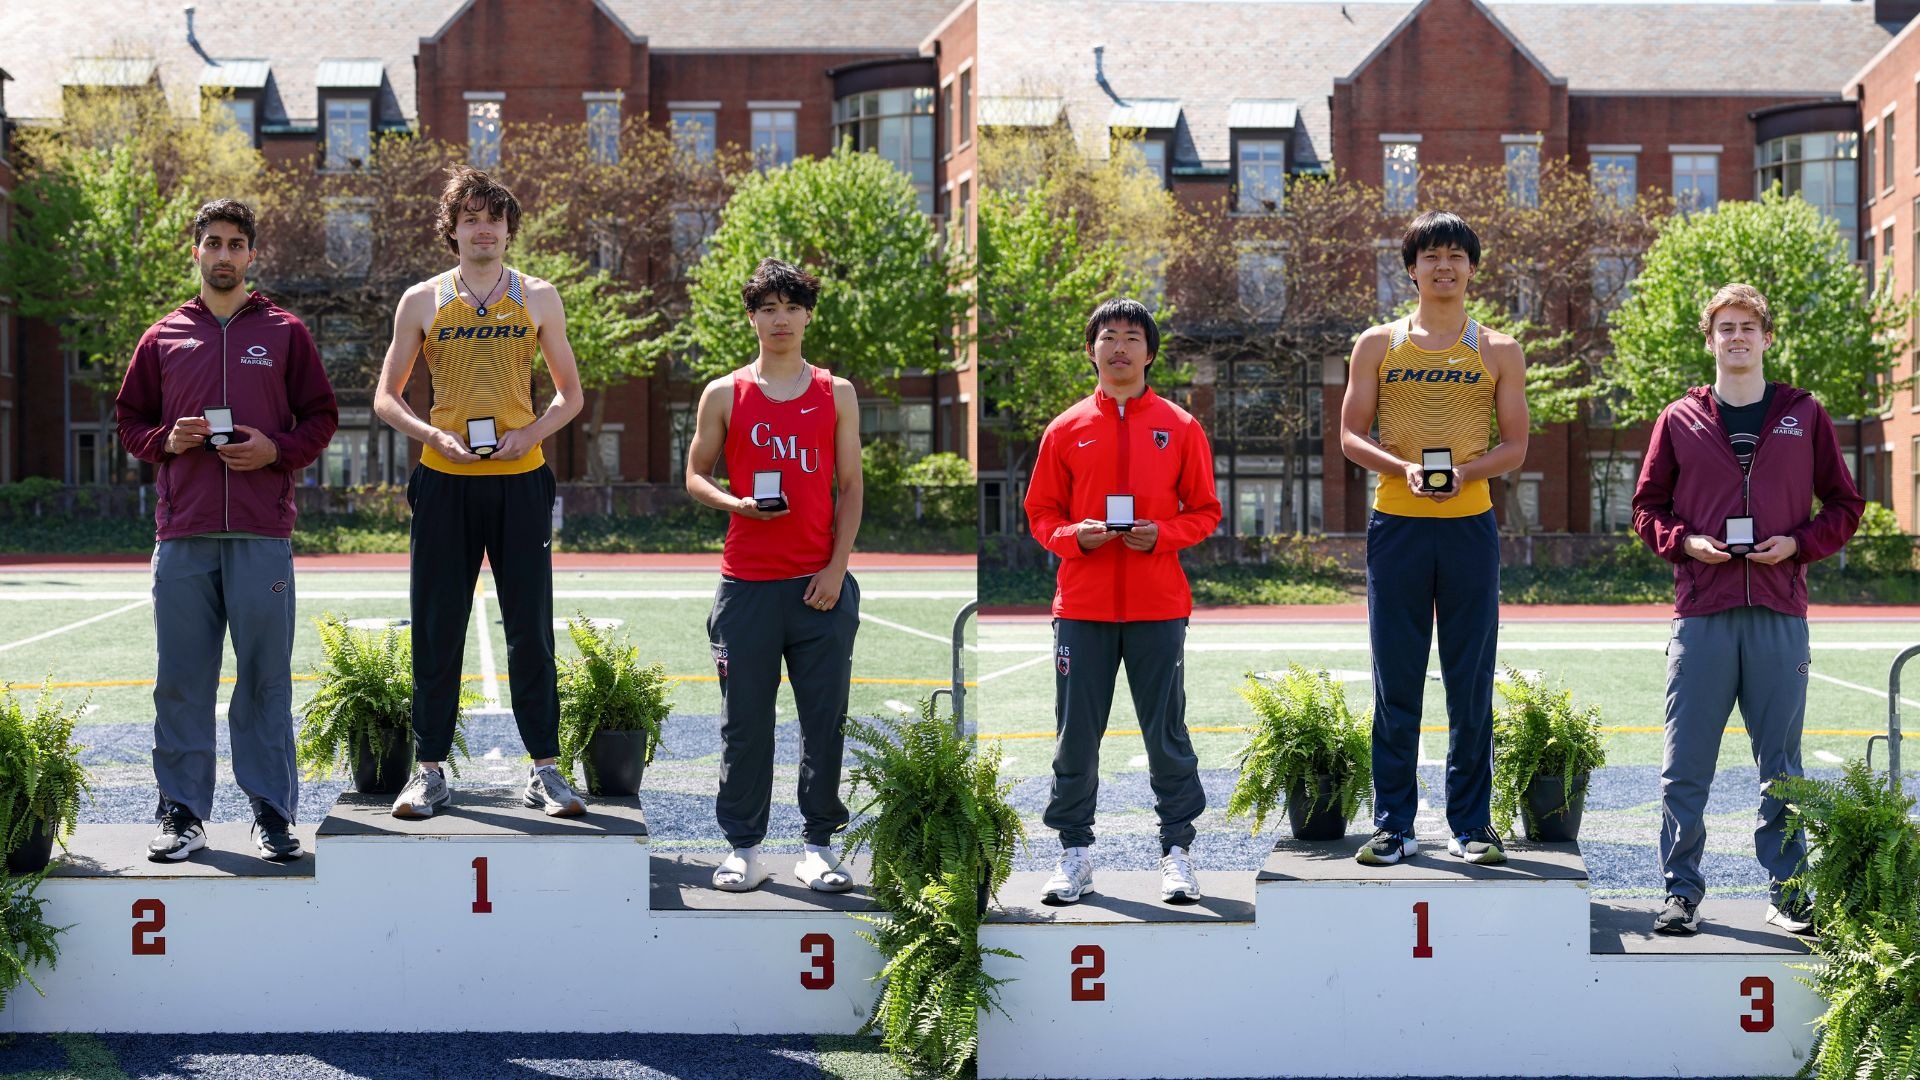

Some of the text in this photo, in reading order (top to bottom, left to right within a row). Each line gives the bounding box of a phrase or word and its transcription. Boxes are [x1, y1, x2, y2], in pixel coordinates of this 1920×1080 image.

[438, 325, 527, 341] EMORY
[1386, 368, 1481, 384] EMORY
[750, 422, 819, 473] CMU
[1058, 645, 1070, 657] 45
[471, 856, 492, 913] 1
[131, 898, 166, 955] 2
[1412, 901, 1433, 958] 1
[800, 933, 835, 990] 3
[1071, 945, 1105, 1001] 2
[1739, 976, 1775, 1032] 3
